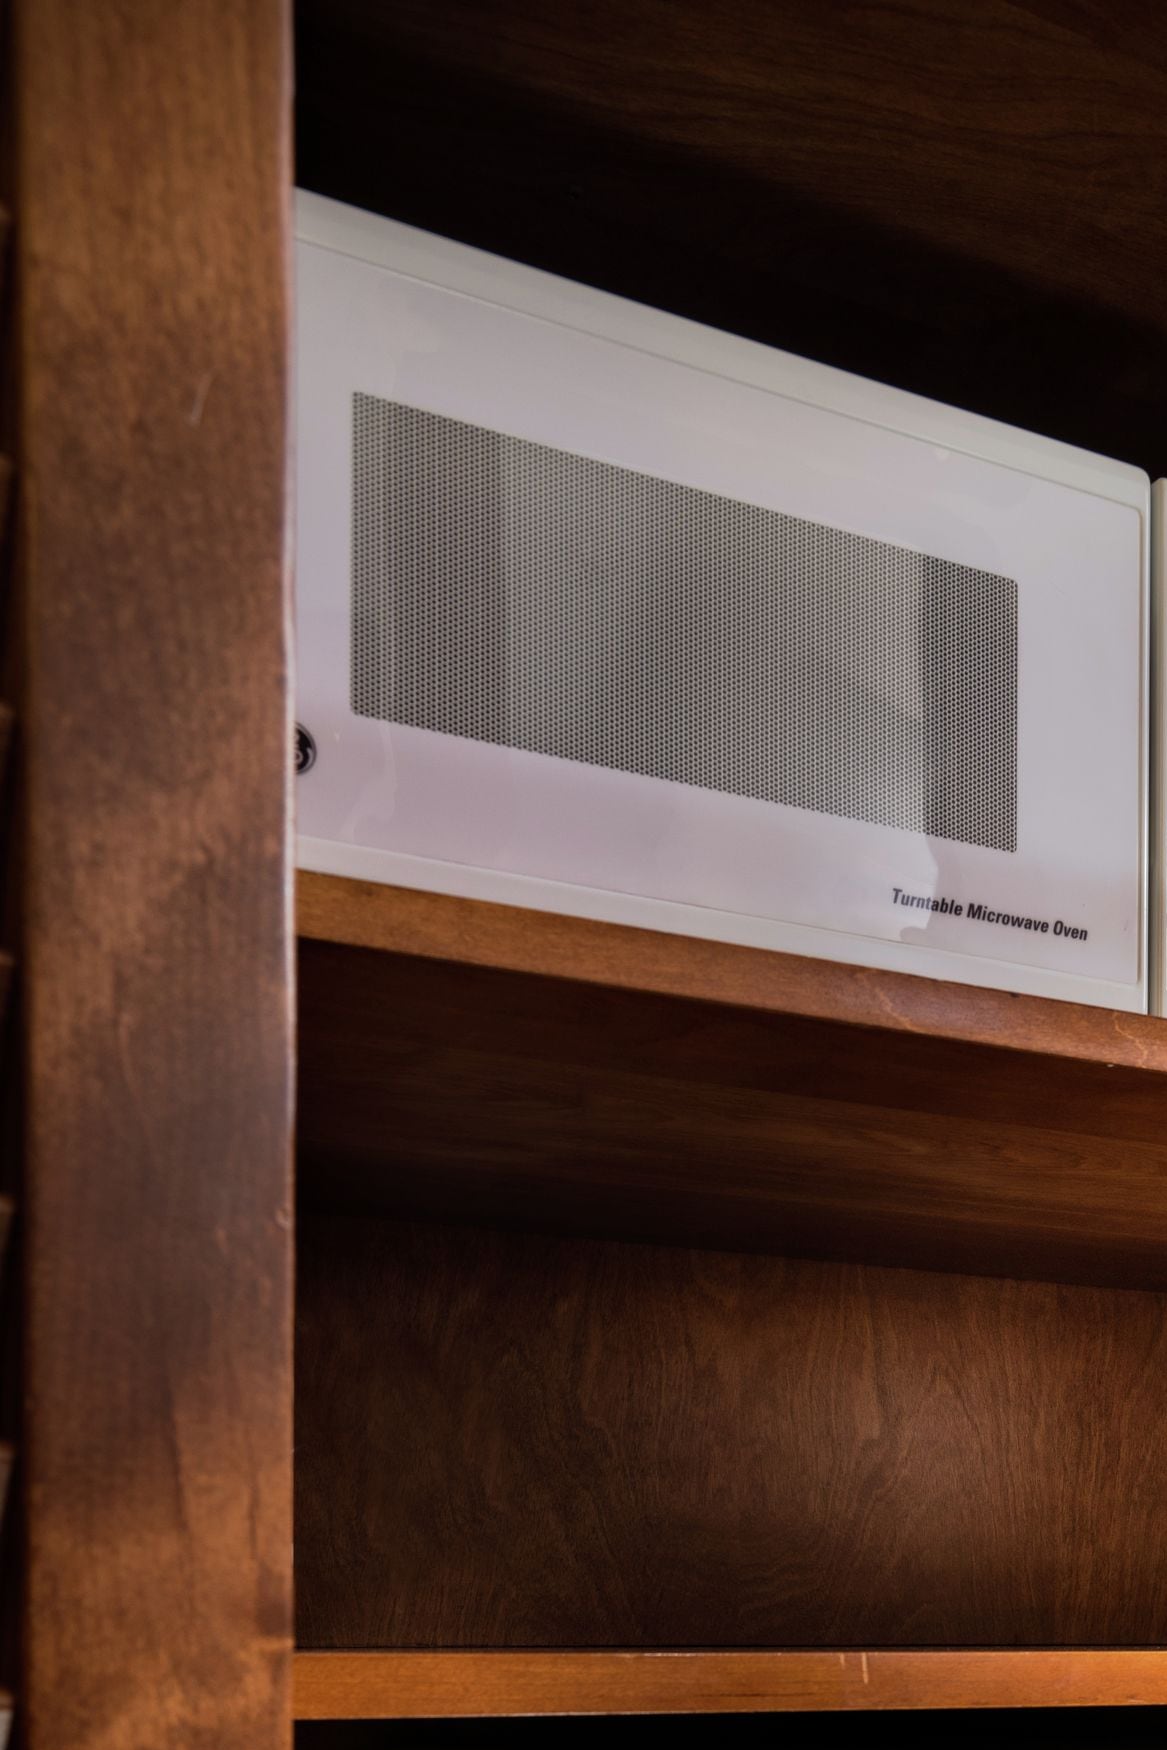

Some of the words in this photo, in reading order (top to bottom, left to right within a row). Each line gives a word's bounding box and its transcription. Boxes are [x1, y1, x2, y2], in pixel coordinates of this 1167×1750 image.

[892, 888, 963, 916] Turntable
[966, 903, 1049, 933] Microwave
[1053, 920, 1088, 941] Oven
